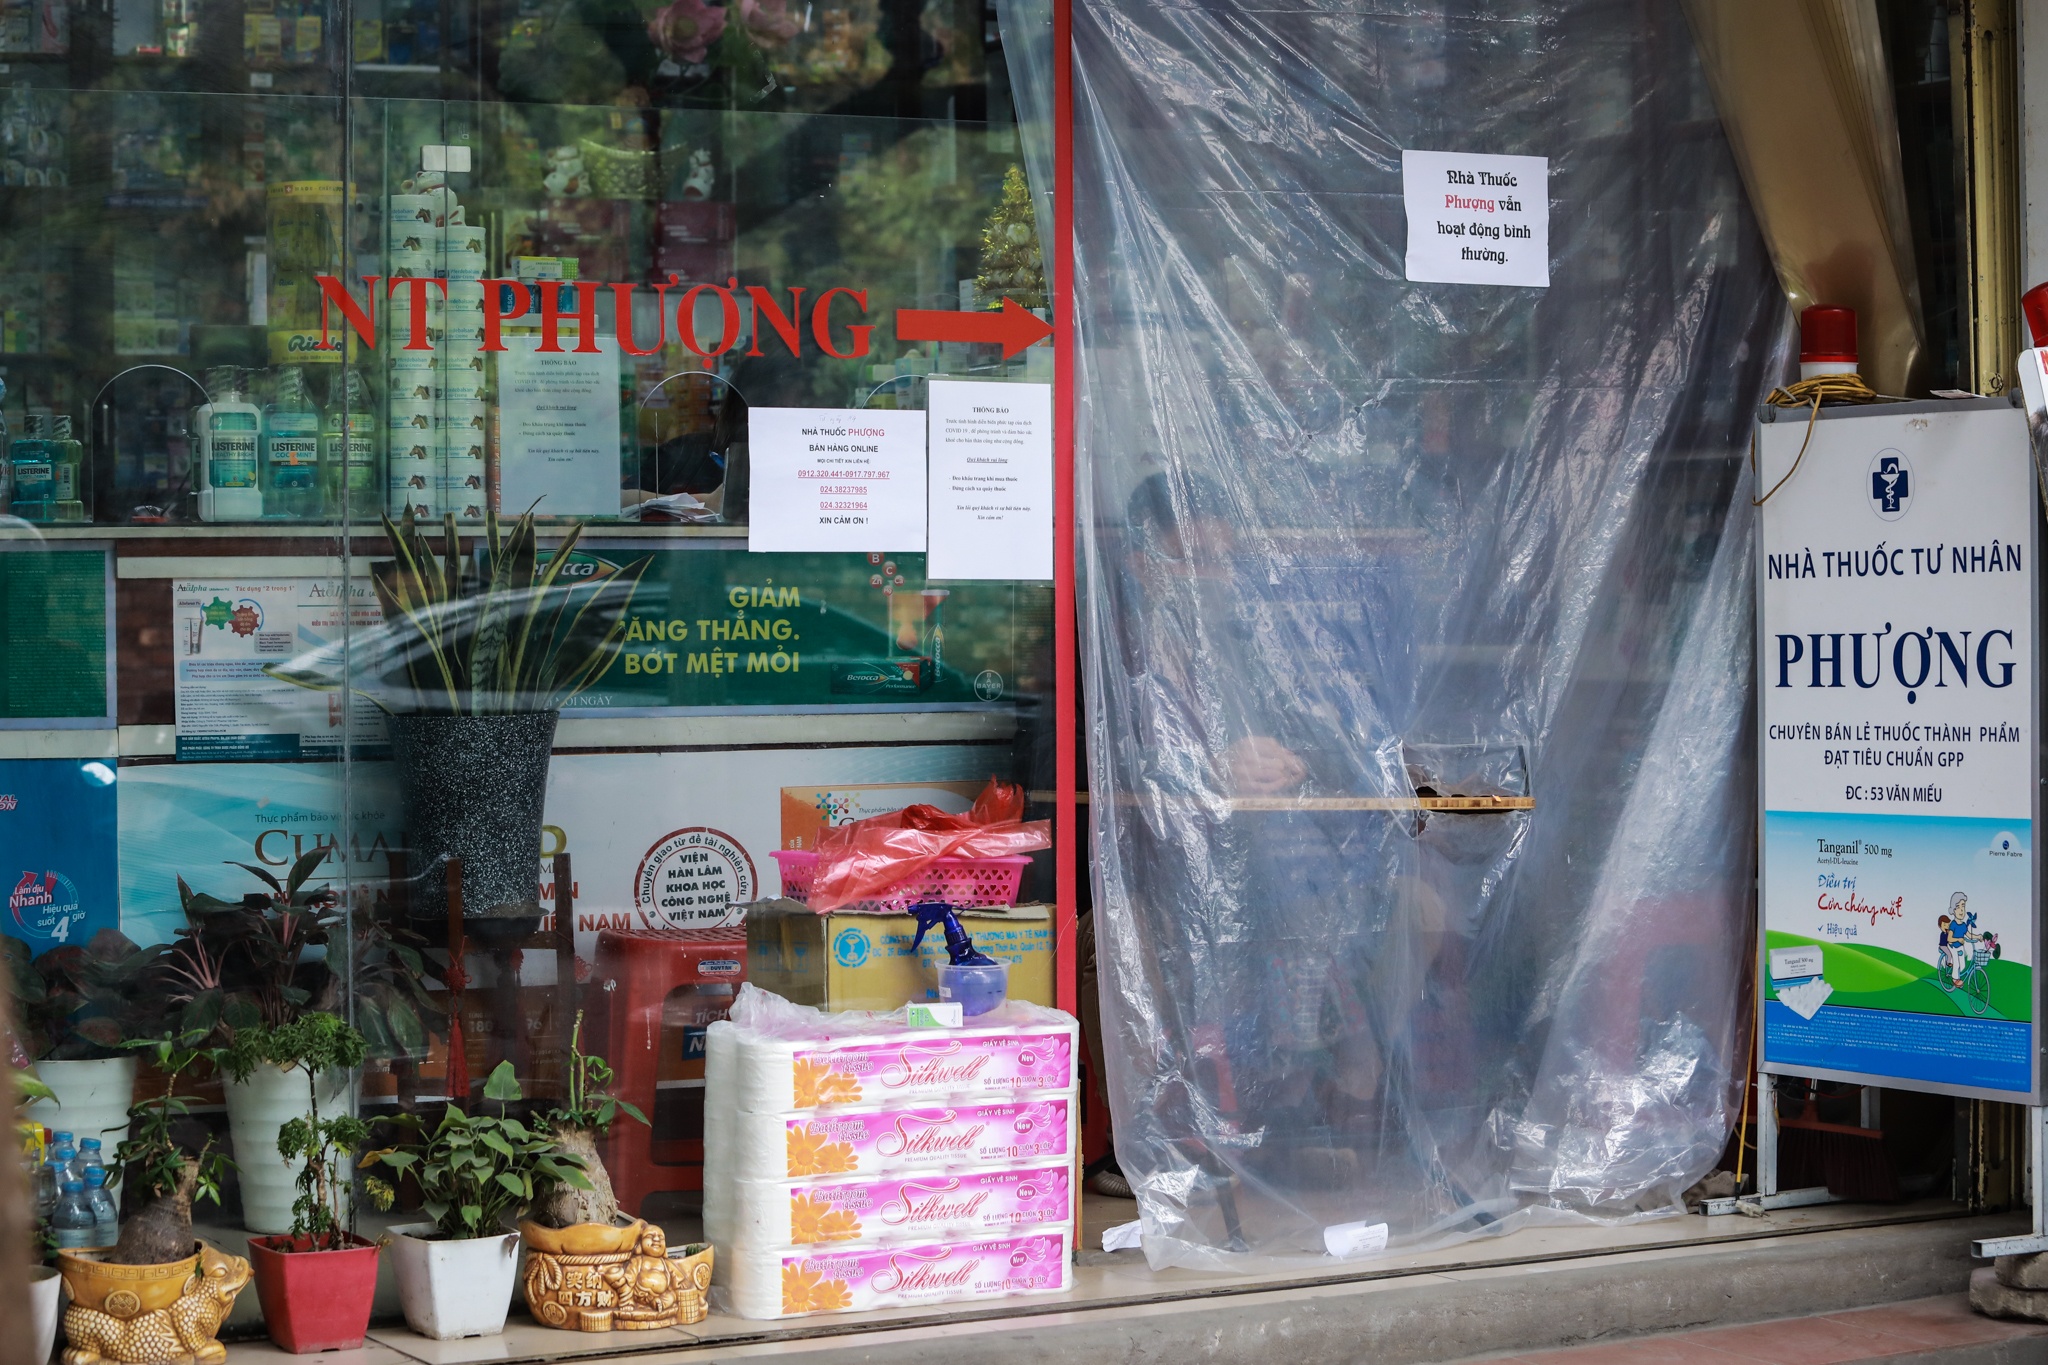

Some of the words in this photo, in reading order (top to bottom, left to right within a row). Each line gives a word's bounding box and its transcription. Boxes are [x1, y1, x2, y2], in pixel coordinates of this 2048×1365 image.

[1446, 170, 1474, 184] Nhà
[1478, 172, 1518, 187] Thuốc
[1445, 194, 1494, 212] Phượng
[1499, 196, 1522, 212] vẫn
[1437, 221, 1466, 238] hoạt
[1470, 222, 1500, 240] động
[1504, 224, 1531, 238] bình
[1462, 247, 1508, 264] thường.
[314, 276, 448, 350] NT
[477, 272, 876, 370] PHƯỢNG
[802, 426, 818, 436] NHÀ
[820, 426, 846, 436] THUỐC
[848, 428, 885, 438] PHƯỢNG
[272, 442, 315, 452] LISTERINE
[809, 443, 825, 452] BÁN
[828, 443, 849, 452] HÀNG
[798, 470, 890, 479] 0912.320.441-0917.797.967
[820, 486, 868, 495] 024.38237985
[820, 502, 868, 510] 024.32321964
[834, 515, 851, 524] CẢM
[872, 554, 880, 563] B
[1768, 547, 1816, 580] NHÀ
[1822, 540, 1904, 578] THUỐC
[1911, 543, 1944, 575] TƯ
[1952, 538, 2022, 574] NHÂN
[886, 566, 893, 575] C
[871, 576, 882, 585] Zn
[729, 578, 800, 608] GIẢM
[619, 616, 688, 642] ĂNG
[696, 610, 800, 641] THẲNG.
[625, 647, 682, 675] BỚT
[686, 646, 738, 678] MỆT
[747, 644, 799, 674] MỎI
[1774, 622, 2016, 704] PHƯỢNG
[580, 694, 613, 706] NGÀY
[1769, 722, 1820, 740] CHUYÊN
[1825, 722, 1851, 741] BÁN
[1856, 721, 1870, 741] LẺ
[1874, 721, 1920, 742] THUỐC
[1924, 723, 1971, 742] THÀNH
[1980, 721, 2020, 743] PHẨM
[1824, 749, 1849, 769] ĐẠT
[1853, 748, 1882, 766] TIÊU
[1886, 746, 1933, 767] CHUẨN
[1938, 752, 1964, 767] GPP
[1846, 786, 1862, 800] ĐC
[1870, 786, 1884, 800] 53
[1886, 784, 1909, 802] VĂN
[1913, 783, 1942, 802] MIẾU
[255, 814, 278, 825] Thực
[280, 811, 308, 824] phẩm
[680, 852, 708, 864] VIỆN
[1864, 844, 1879, 855] 500
[1881, 846, 1893, 858] mg
[1817, 857, 1859, 866] Acetyl-DL-leucine
[642, 864, 656, 904] Chuyển
[654, 844, 673, 864] giao
[674, 838, 686, 848] từ
[689, 834, 701, 844] đề
[704, 836, 718, 848] tài
[718, 844, 745, 872] nghiên
[740, 874, 749, 895] cứu
[668, 866, 693, 879] HÀN
[698, 865, 722, 876] LÂM
[666, 881, 699, 893] KHOA
[702, 880, 725, 891] HỌC
[1818, 872, 1840, 888] Điều
[1843, 876, 1856, 892] trị
[14, 886, 31, 895] Làm
[32, 884, 44, 894] dịu
[9, 892, 52, 908] Nhanh
[661, 896, 694, 907] CÔNG
[42, 904, 62, 915] Hiệu
[63, 900, 78, 912] quả
[1817, 893, 1843, 912] Cơn
[1845, 893, 1879, 926] chóng
[1880, 895, 1903, 920] mặt
[579, 912, 630, 932] NAM
[668, 911, 694, 922] VIỆT
[698, 908, 726, 919] NAM
[37, 914, 56, 927] suốt
[51, 916, 70, 942] 4
[72, 911, 86, 923] giờ
[1827, 924, 1843, 936] Hiệu
[1844, 924, 1858, 939] quả
[983, 1039, 997, 1047] GIẤY
[842, 1062, 874, 1073] tissue
[881, 1040, 990, 1088] Silkwell
[1010, 1076, 1021, 1087] 10
[810, 1118, 864, 1134] Bathroom
[876, 1109, 985, 1157] Silkwell
[1017, 1122, 1031, 1130] New
[838, 1129, 869, 1142] tissue
[1006, 1146, 1018, 1157] 10
[1034, 1143, 1039, 1154] 3
[814, 1186, 867, 1202] Bathroom
[1020, 1188, 1033, 1196] New
[842, 1198, 873, 1210] tissue
[880, 1178, 988, 1225] Silkwell
[1009, 1212, 1021, 1223] 10
[1038, 1210, 1044, 1222] 3
[989, 1243, 997, 1251] VỆ
[805, 1255, 859, 1272] Bathroom
[1012, 1256, 1025, 1264] New
[833, 1267, 864, 1279] tissue
[870, 1246, 979, 1294] Silkwell
[566, 1271, 602, 1289] 笑纳
[1001, 1278, 1011, 1289] 10
[1028, 1277, 1034, 1288] 3
[558, 1290, 613, 1307] 四方财
